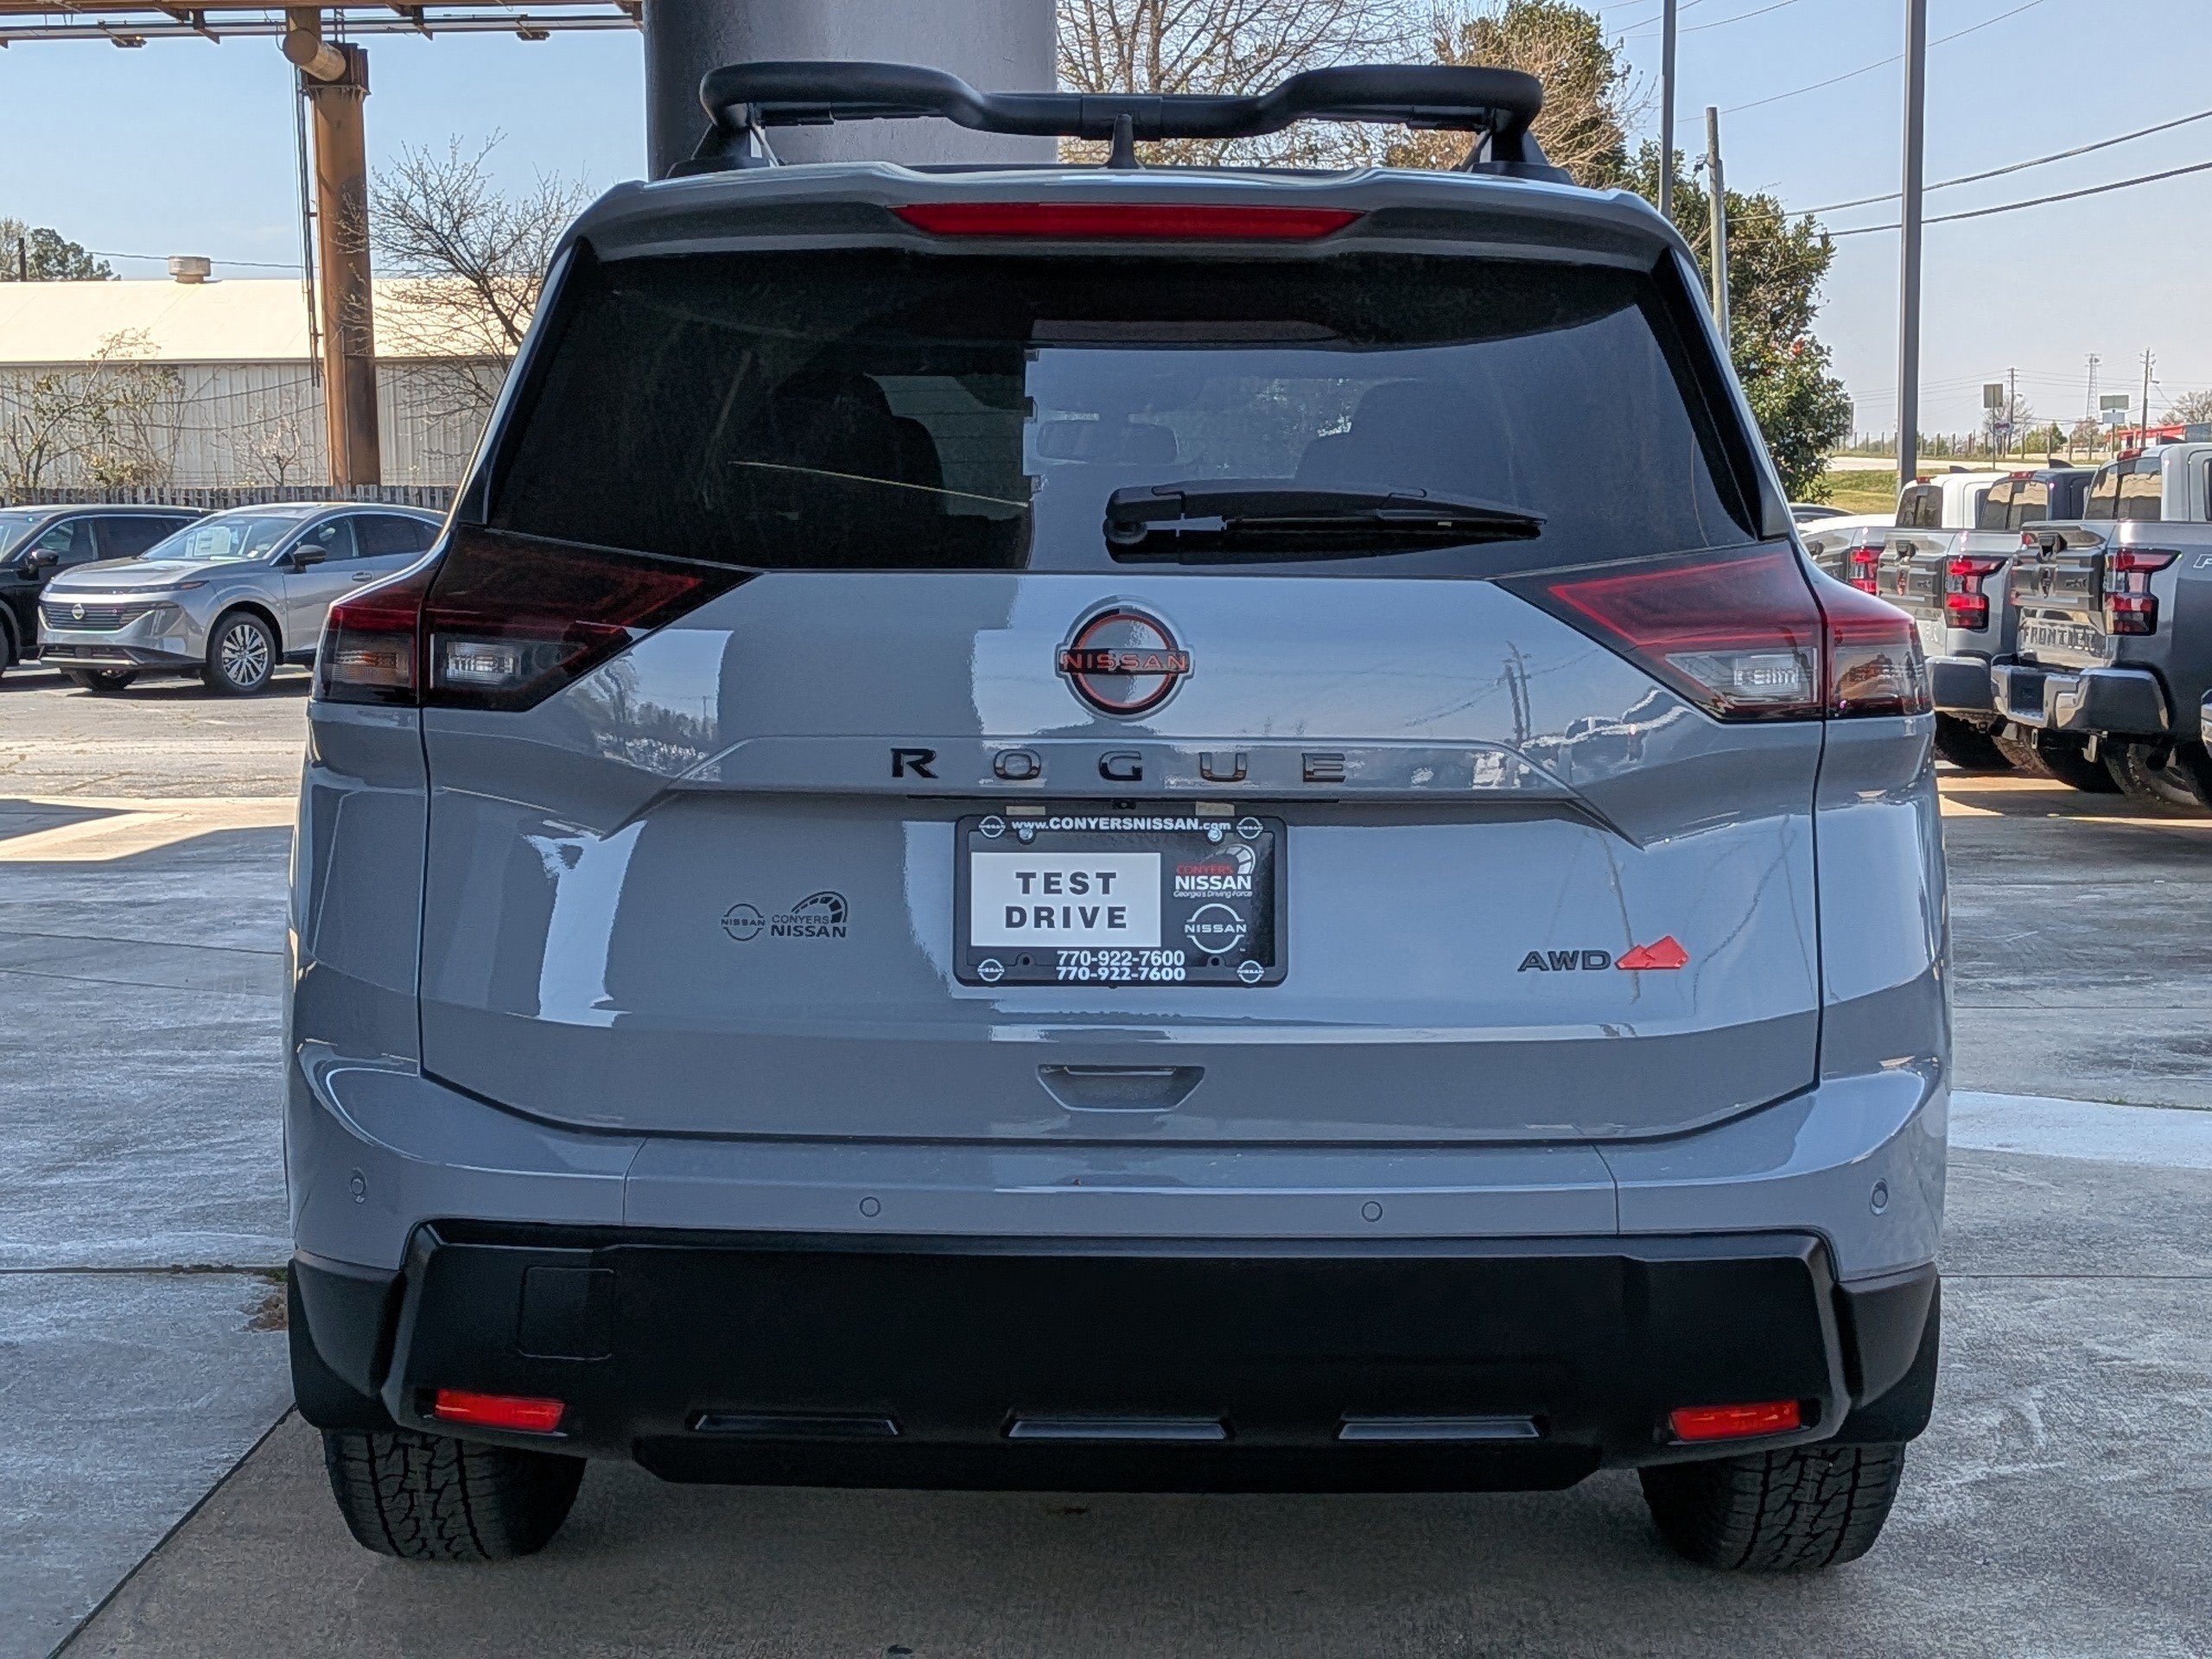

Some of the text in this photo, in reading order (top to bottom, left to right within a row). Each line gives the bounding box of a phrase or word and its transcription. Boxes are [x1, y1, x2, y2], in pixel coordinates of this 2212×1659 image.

[1061, 652, 1187, 671] NISSAN
[891, 748, 1346, 782] ROGUE
[1011, 817, 1231, 830] www.CONYERSNISSAN.com
[1015, 872, 1116, 895] TEST
[1175, 875, 1251, 890] NISSAN
[772, 914, 830, 925] CONYERS
[1005, 906, 1127, 929] DRIVE
[771, 925, 846, 938] NISSAN
[1185, 924, 1247, 933] NISSAN
[1057, 950, 1185, 966] 770-922-7600
[1517, 950, 1611, 971] AWD
[1056, 966, 1186, 981] 770-922-7600
